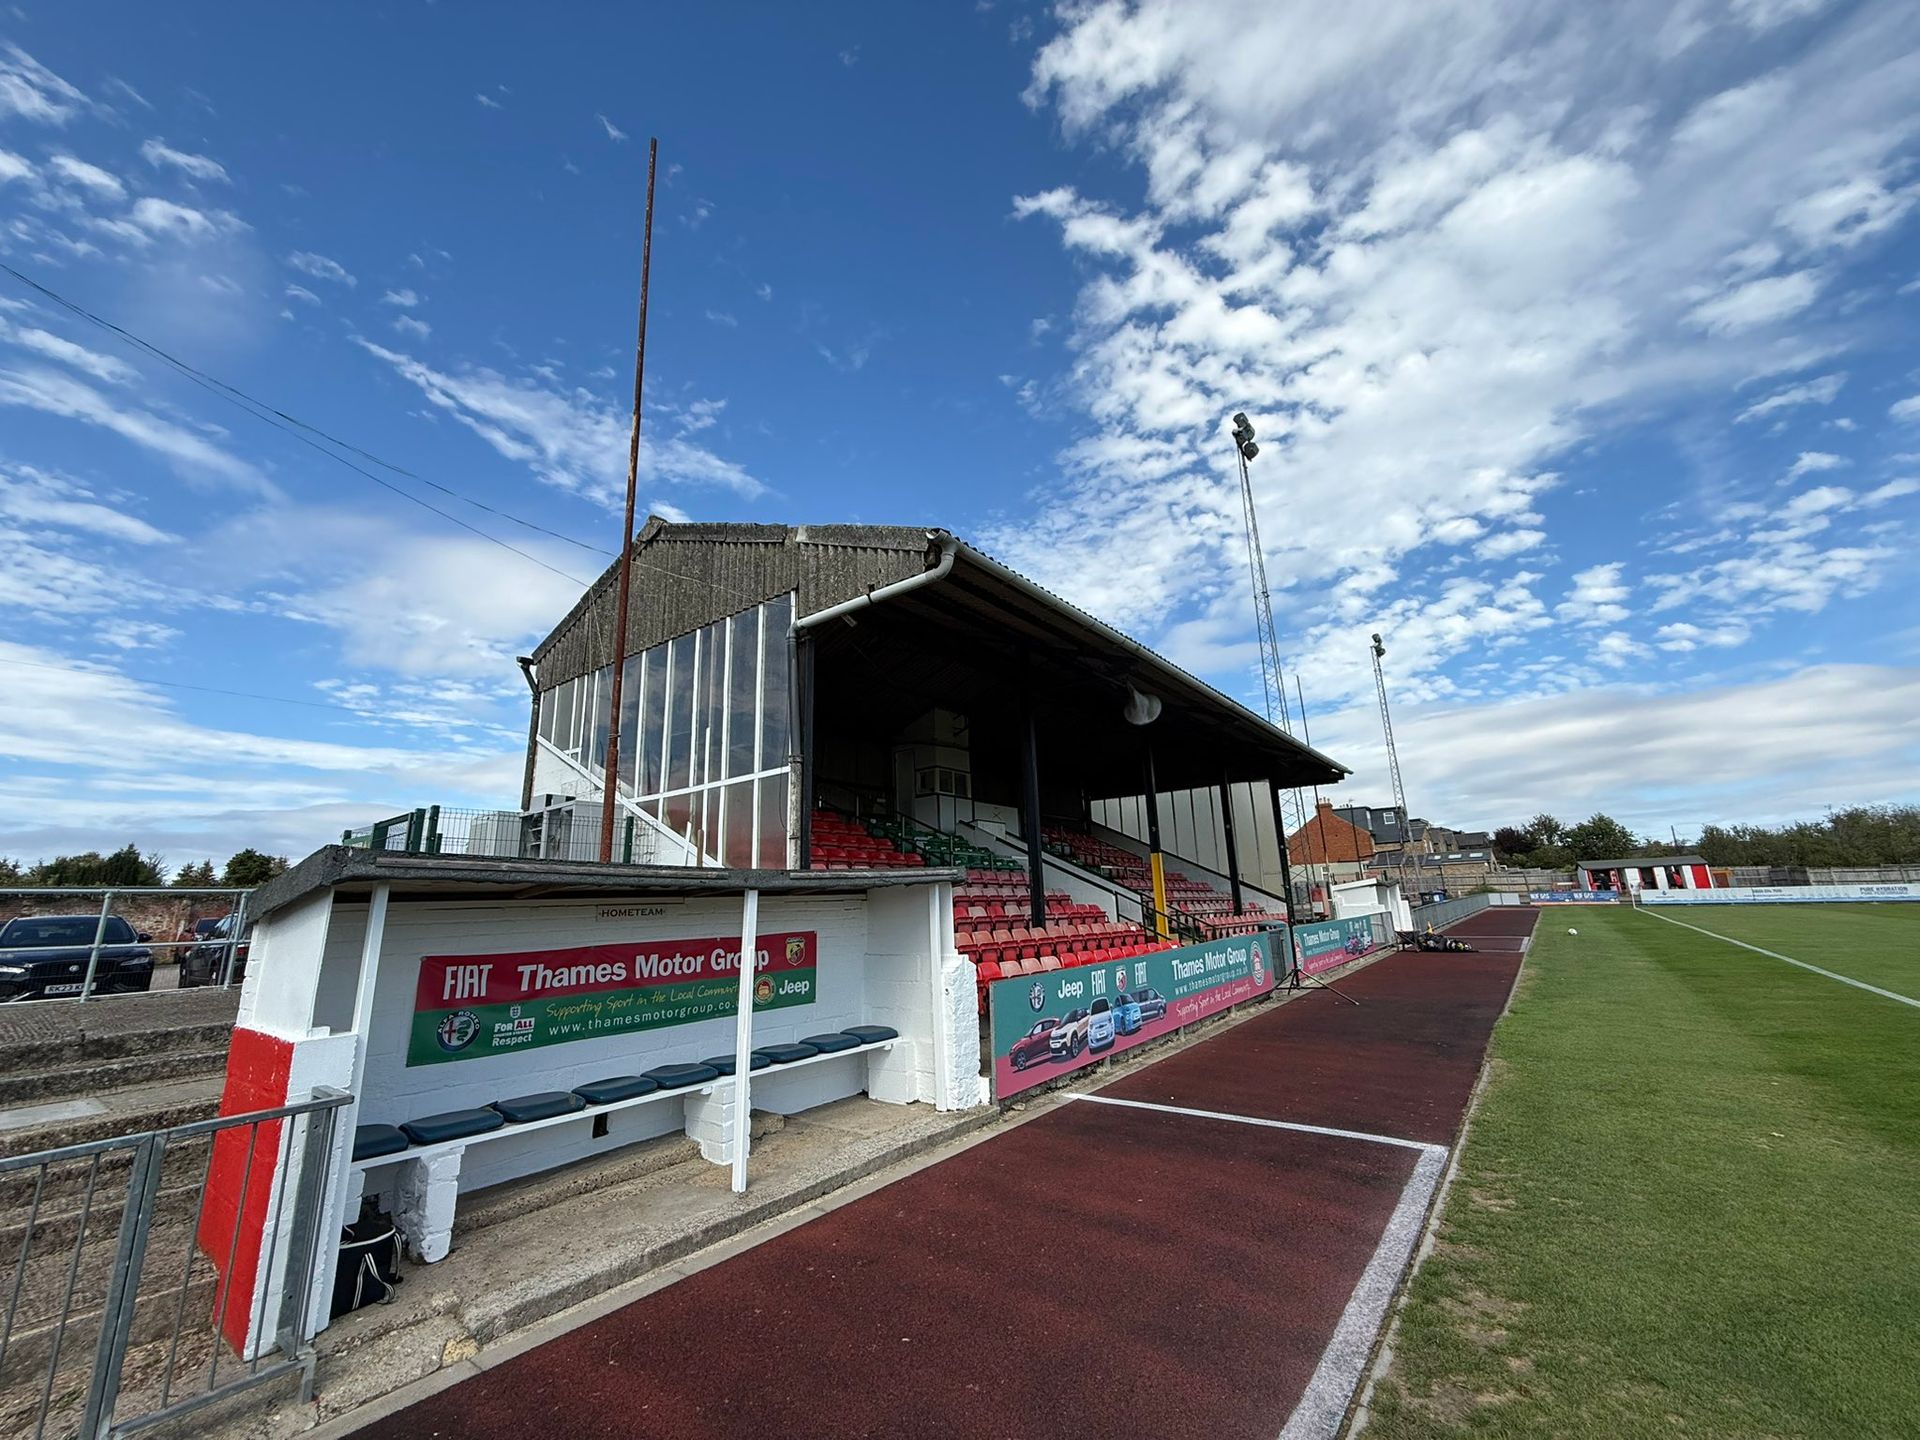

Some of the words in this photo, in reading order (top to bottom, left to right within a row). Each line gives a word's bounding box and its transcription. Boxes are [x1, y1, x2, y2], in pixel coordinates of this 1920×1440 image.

[601, 908, 664, 917] HOMETEAM
[517, 963, 627, 992] Thames
[635, 953, 704, 979] Motor
[710, 948, 770, 971] Grop
[1134, 962, 1147, 985] FIAT
[1172, 958, 1204, 980] Thames
[1204, 951, 1226, 971] Motor
[1227, 947, 1247, 965] Group
[443, 964, 493, 1000] FIAT
[778, 979, 810, 995] Jeep
[1058, 980, 1084, 998] Jeep
[1091, 969, 1106, 996] FIAT
[546, 1000, 601, 1020] Supporting
[606, 996, 633, 1013] Sport
[636, 993, 647, 1006] in
[651, 990, 666, 1003] the
[670, 986, 695, 1002] Local
[697, 982, 740, 999] Communit
[438, 1014, 454, 1034] ALFA
[458, 1011, 480, 1030] ROMEO
[516, 1020, 533, 1029] ALL
[492, 1033, 532, 1047] Respect
